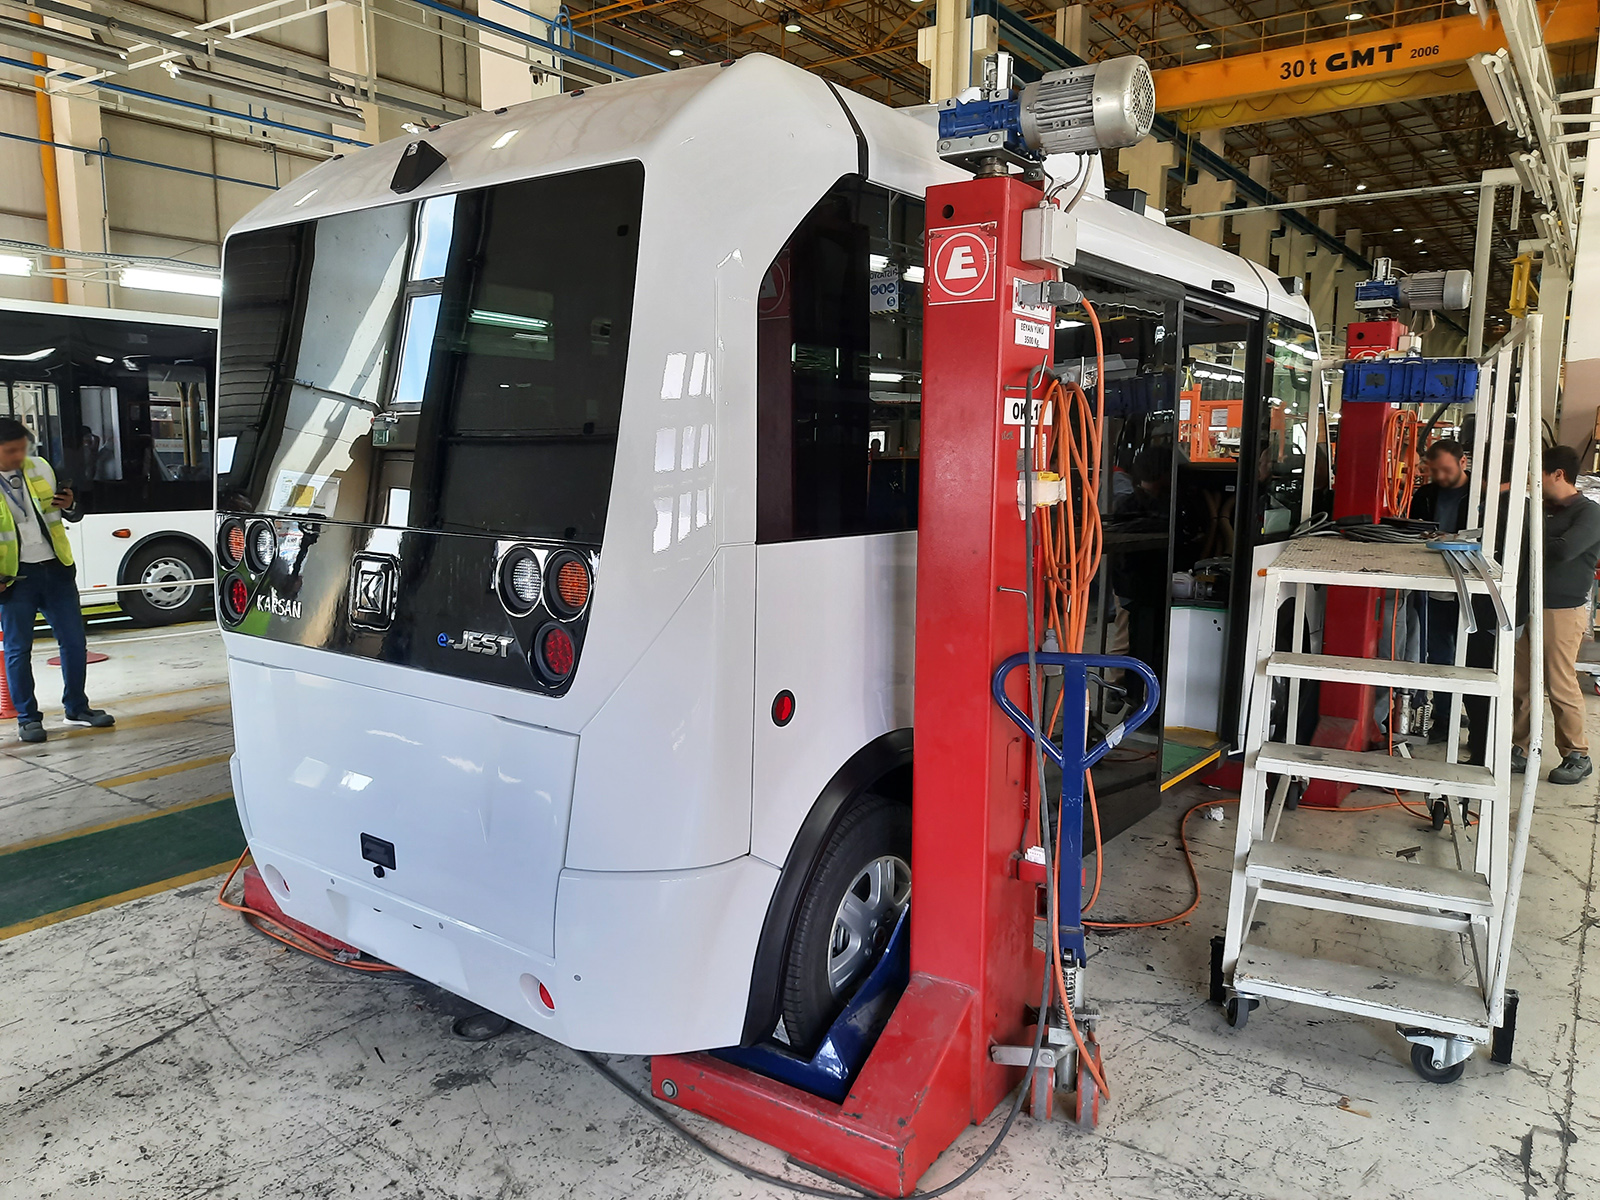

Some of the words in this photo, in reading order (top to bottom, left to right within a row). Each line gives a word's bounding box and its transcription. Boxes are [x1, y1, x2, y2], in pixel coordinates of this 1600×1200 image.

[1279, 60, 1305, 80] 30
[1309, 59, 1317, 75] t
[1325, 43, 1402, 72] GMT
[1410, 45, 1440, 60] 2006
[944, 245, 978, 280] E
[1020, 322, 1034, 334] BEYAN
[1034, 323, 1045, 335] YÜKÜ
[1024, 335, 1033, 344] 3500
[1011, 401, 1040, 420] OK.1
[256, 594, 302, 619] KARSAN
[437, 630, 515, 658] e-JEST
